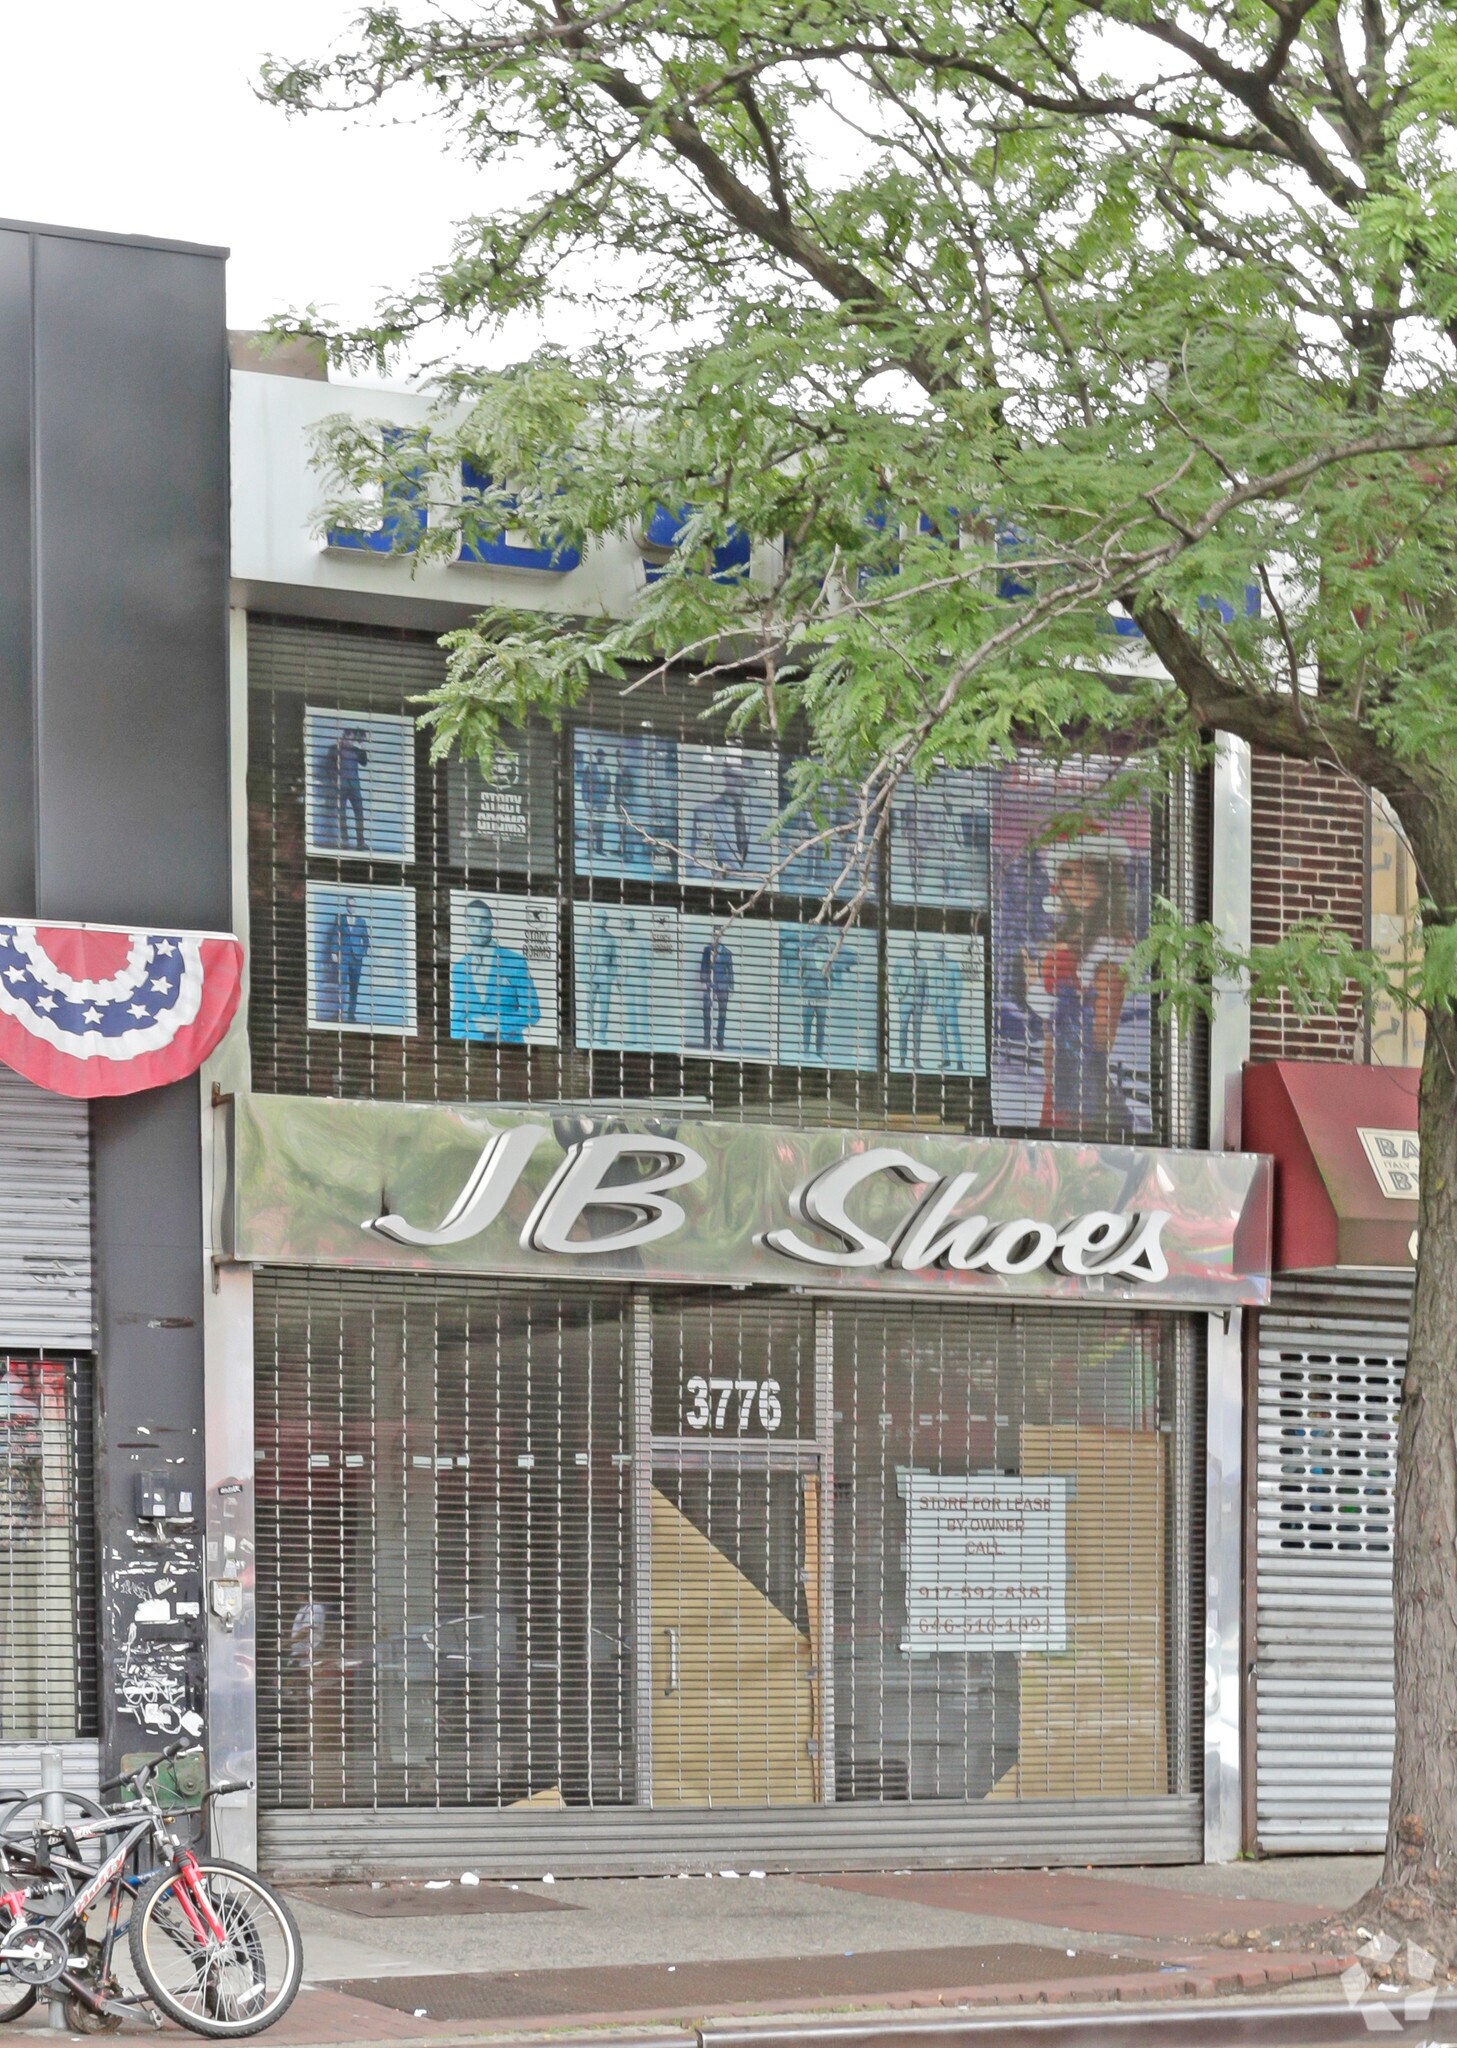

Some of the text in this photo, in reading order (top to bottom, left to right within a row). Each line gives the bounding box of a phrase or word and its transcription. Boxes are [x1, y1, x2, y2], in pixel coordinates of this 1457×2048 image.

[361, 1124, 1171, 1283] JB Shoes
[686, 1375, 782, 1431] 3776
[919, 1496, 1050, 1512] STORE FOR LEASE
[947, 1518, 1024, 1532] BY OWNER
